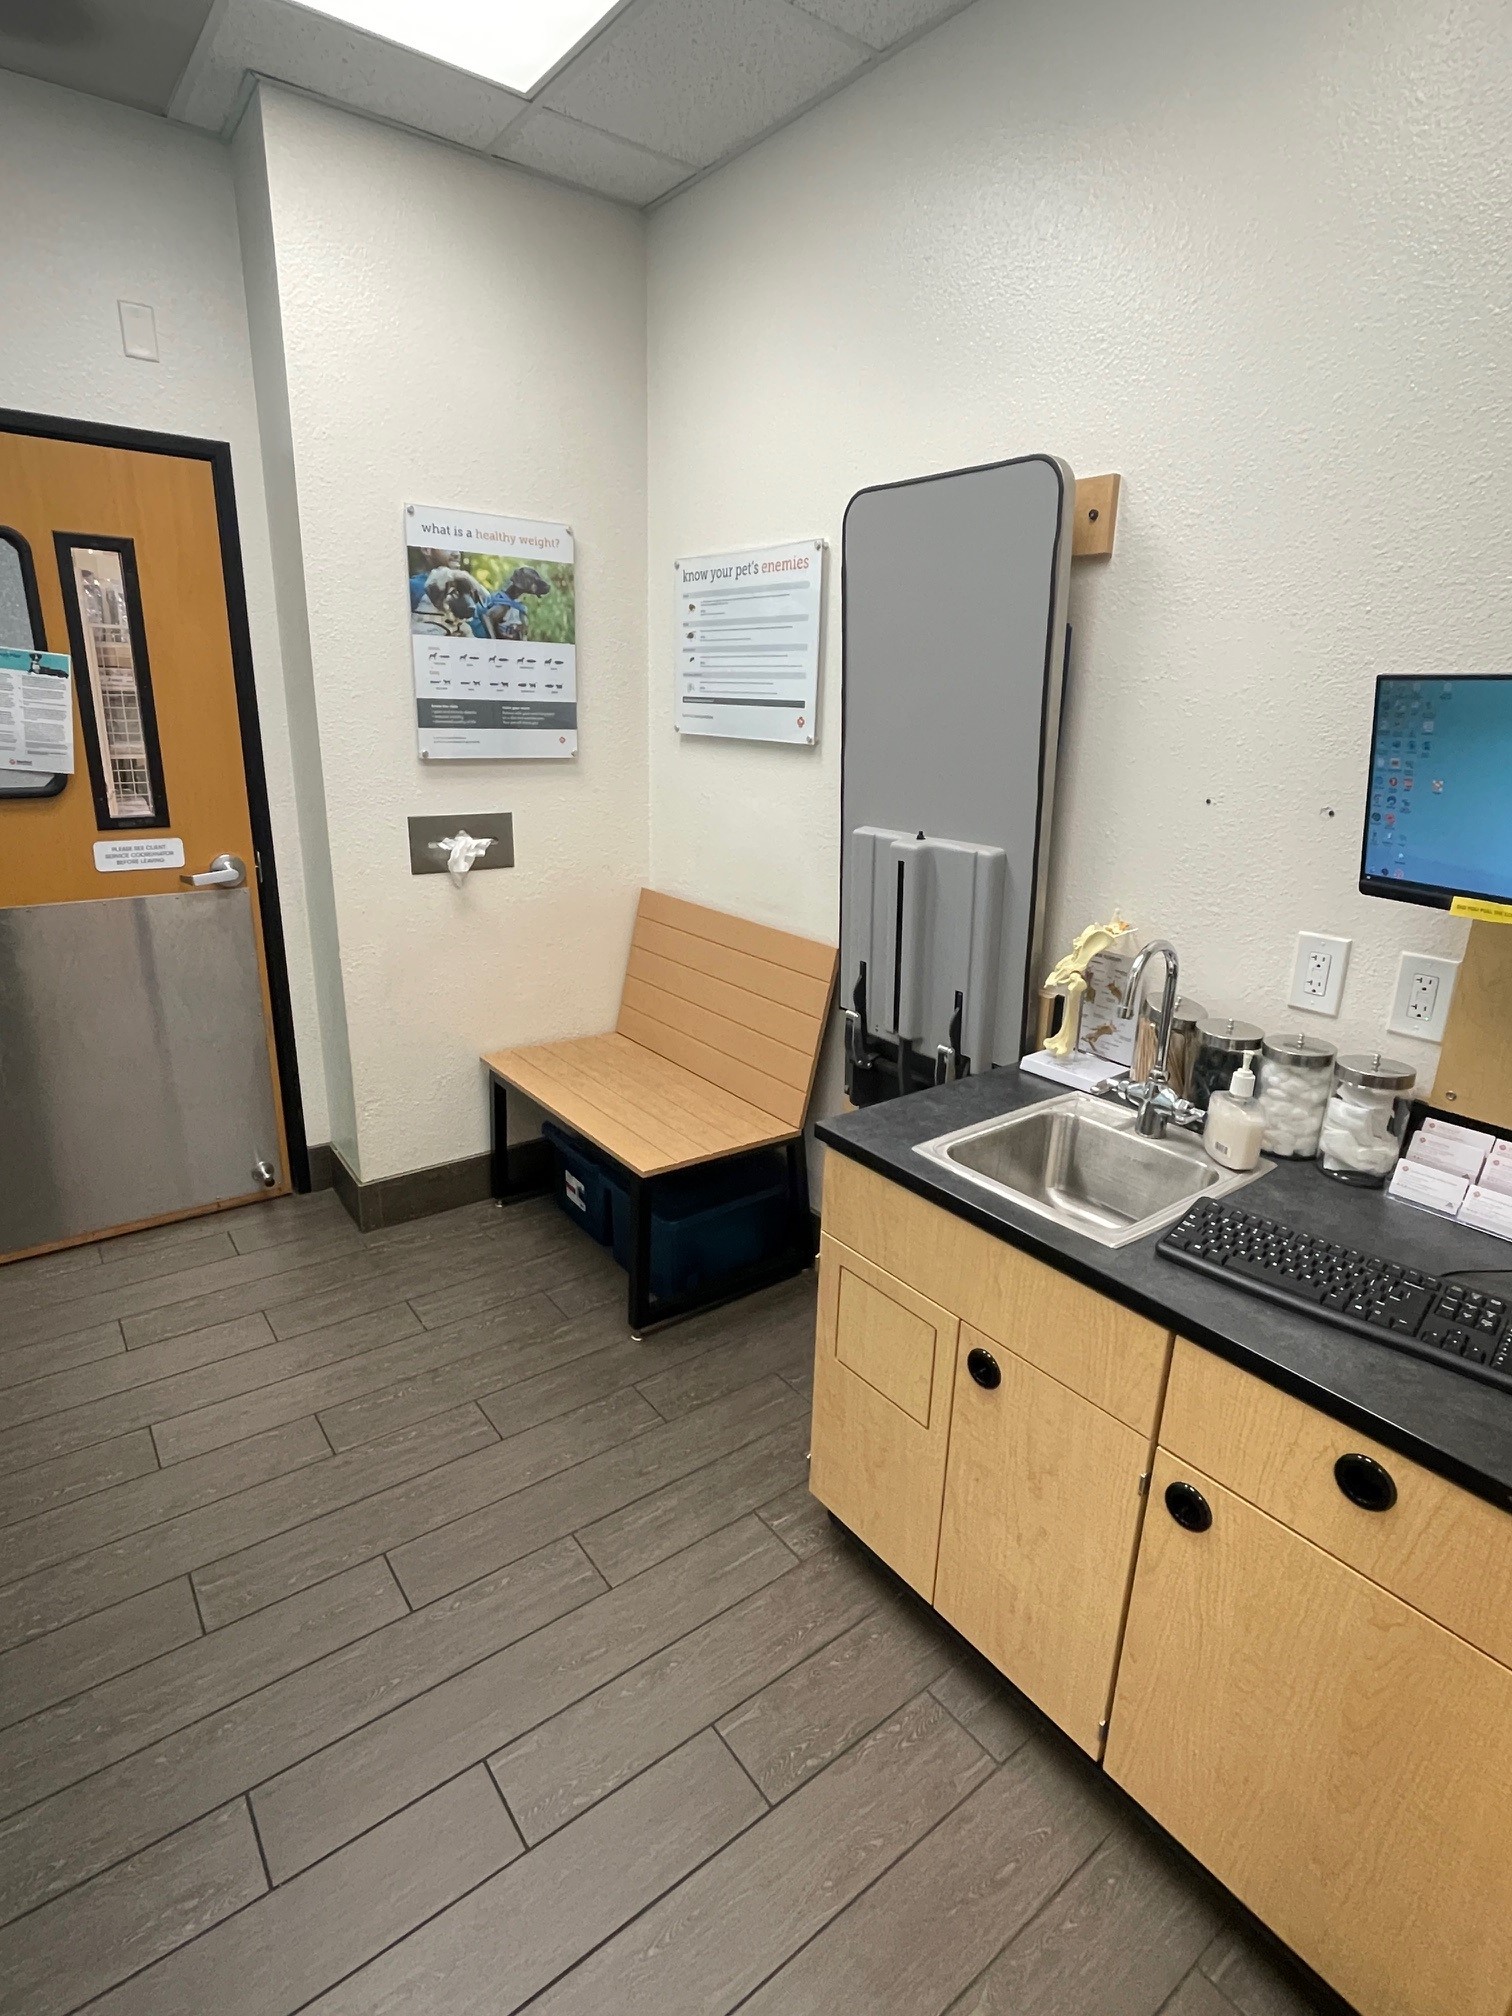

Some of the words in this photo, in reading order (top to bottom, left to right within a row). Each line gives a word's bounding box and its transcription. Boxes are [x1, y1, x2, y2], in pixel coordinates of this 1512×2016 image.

[421, 523, 451, 536] what
[454, 526, 463, 537] is
[466, 530, 472, 538] a
[475, 529, 516, 545] healthy
[519, 536, 560, 549] weight?
[683, 569, 708, 582] know
[710, 567, 733, 583] your
[735, 560, 759, 580] pet's
[761, 556, 809, 573] enemies
